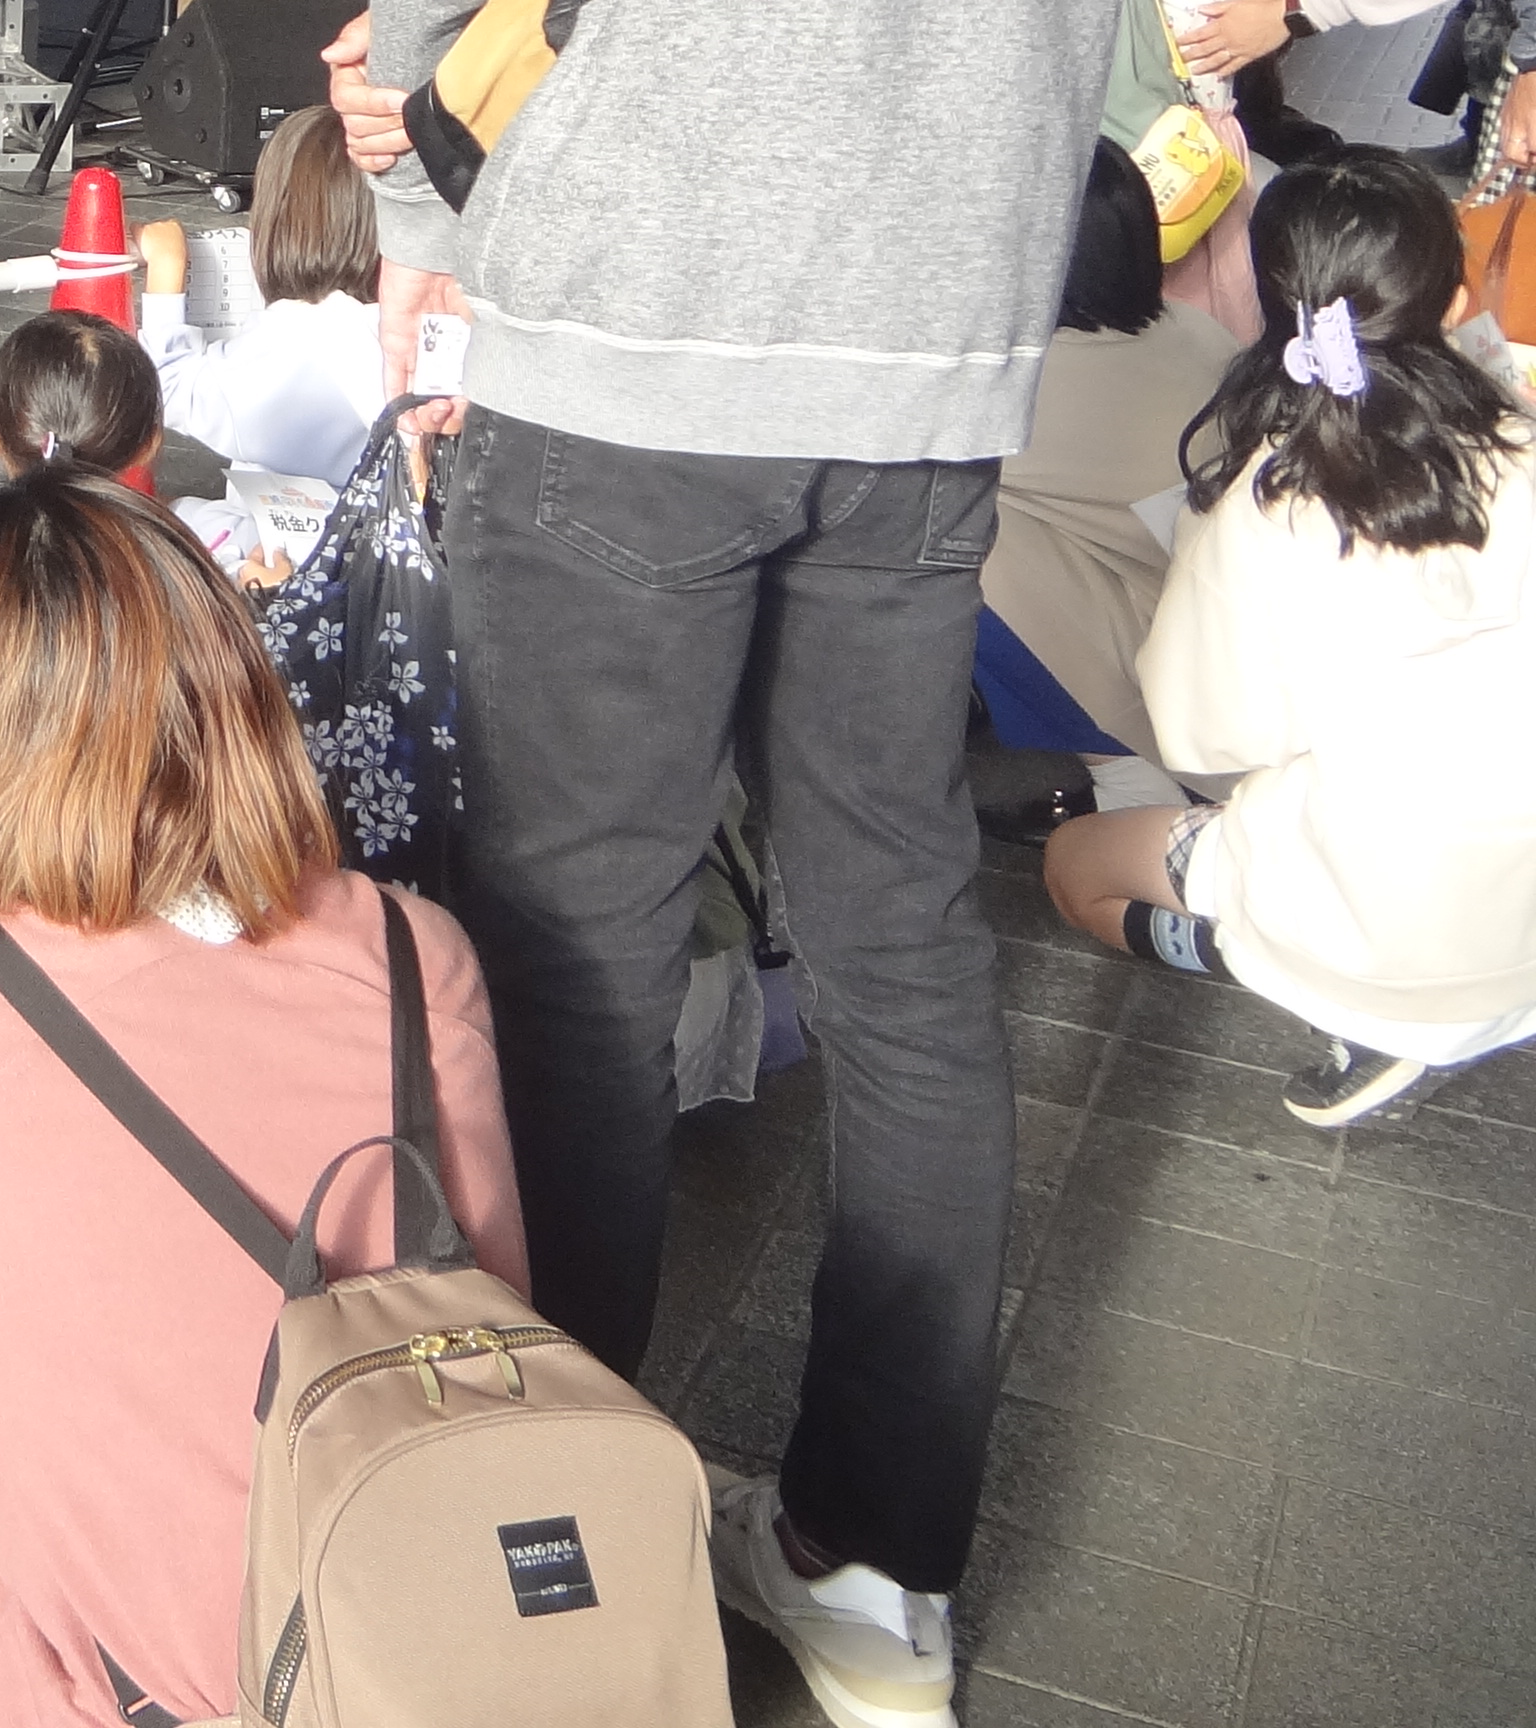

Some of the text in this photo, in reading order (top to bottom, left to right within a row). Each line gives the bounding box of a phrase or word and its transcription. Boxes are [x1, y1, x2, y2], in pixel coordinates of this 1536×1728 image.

[268, 514, 321, 533] 税金ク
[546, 1538, 573, 1555] PAK
